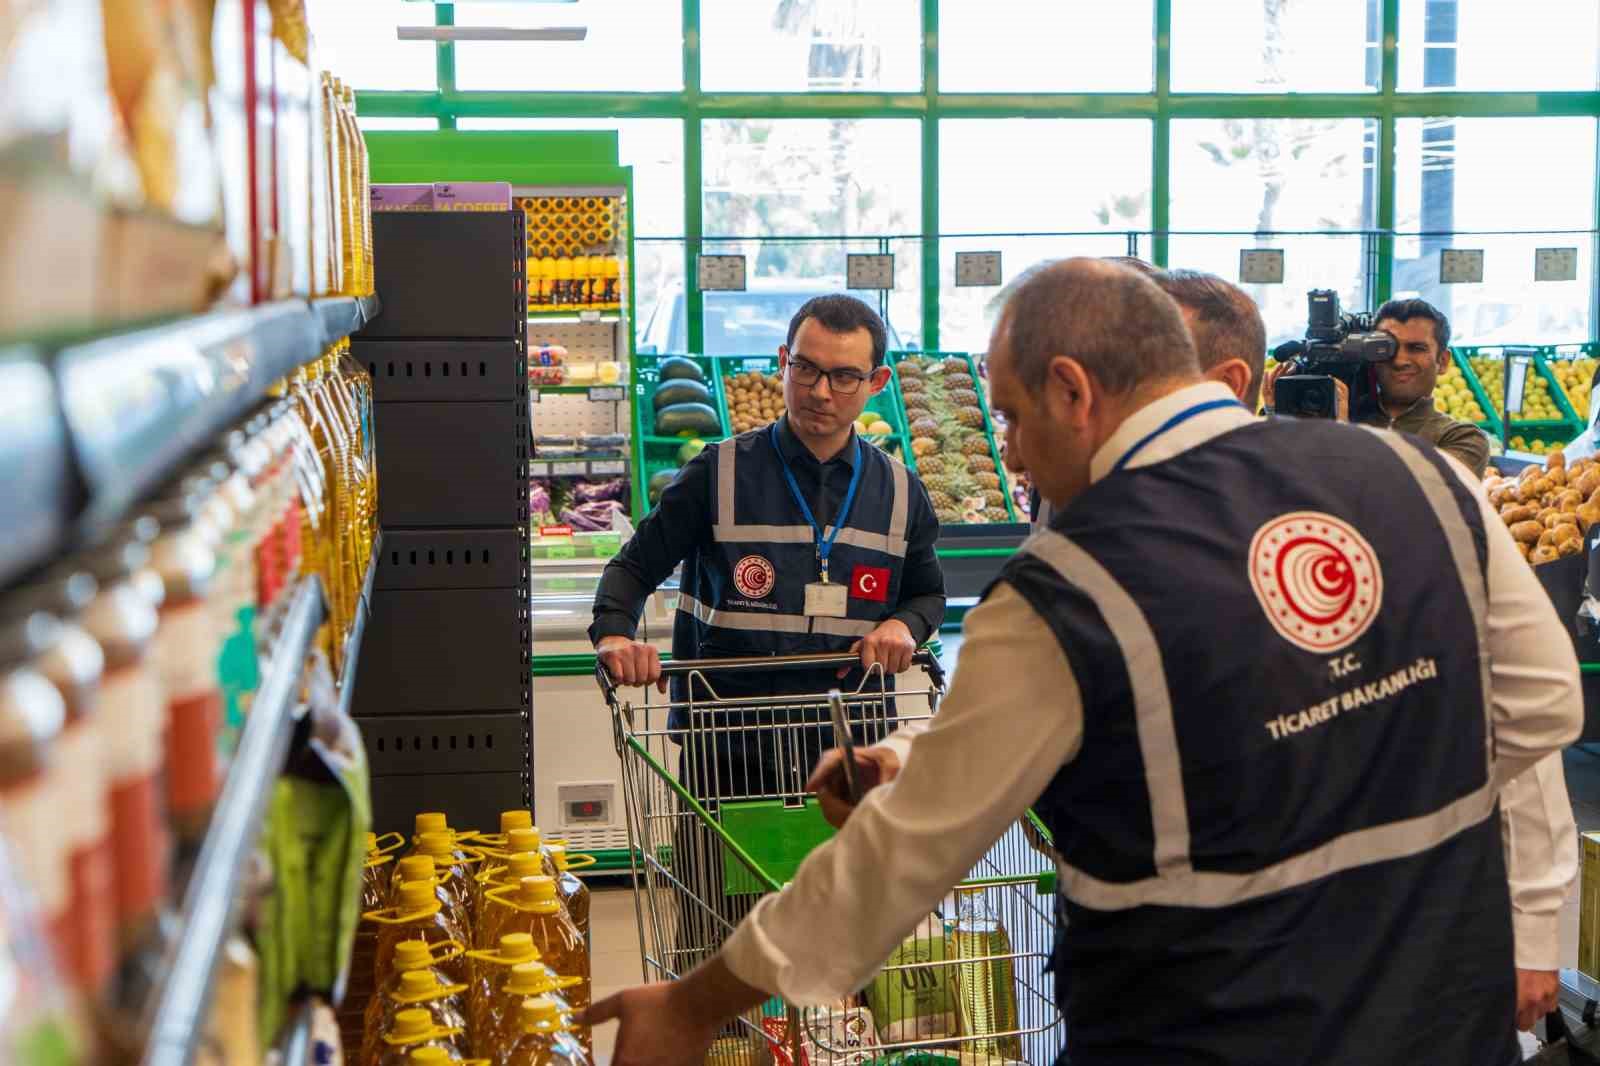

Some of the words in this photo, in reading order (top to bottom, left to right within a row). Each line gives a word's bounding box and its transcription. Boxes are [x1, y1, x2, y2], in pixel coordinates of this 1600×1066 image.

[1328, 653, 1362, 678] T.C.
[1265, 696, 1339, 740] TİCARET
[1340, 657, 1438, 711] BAKANLIĞI
